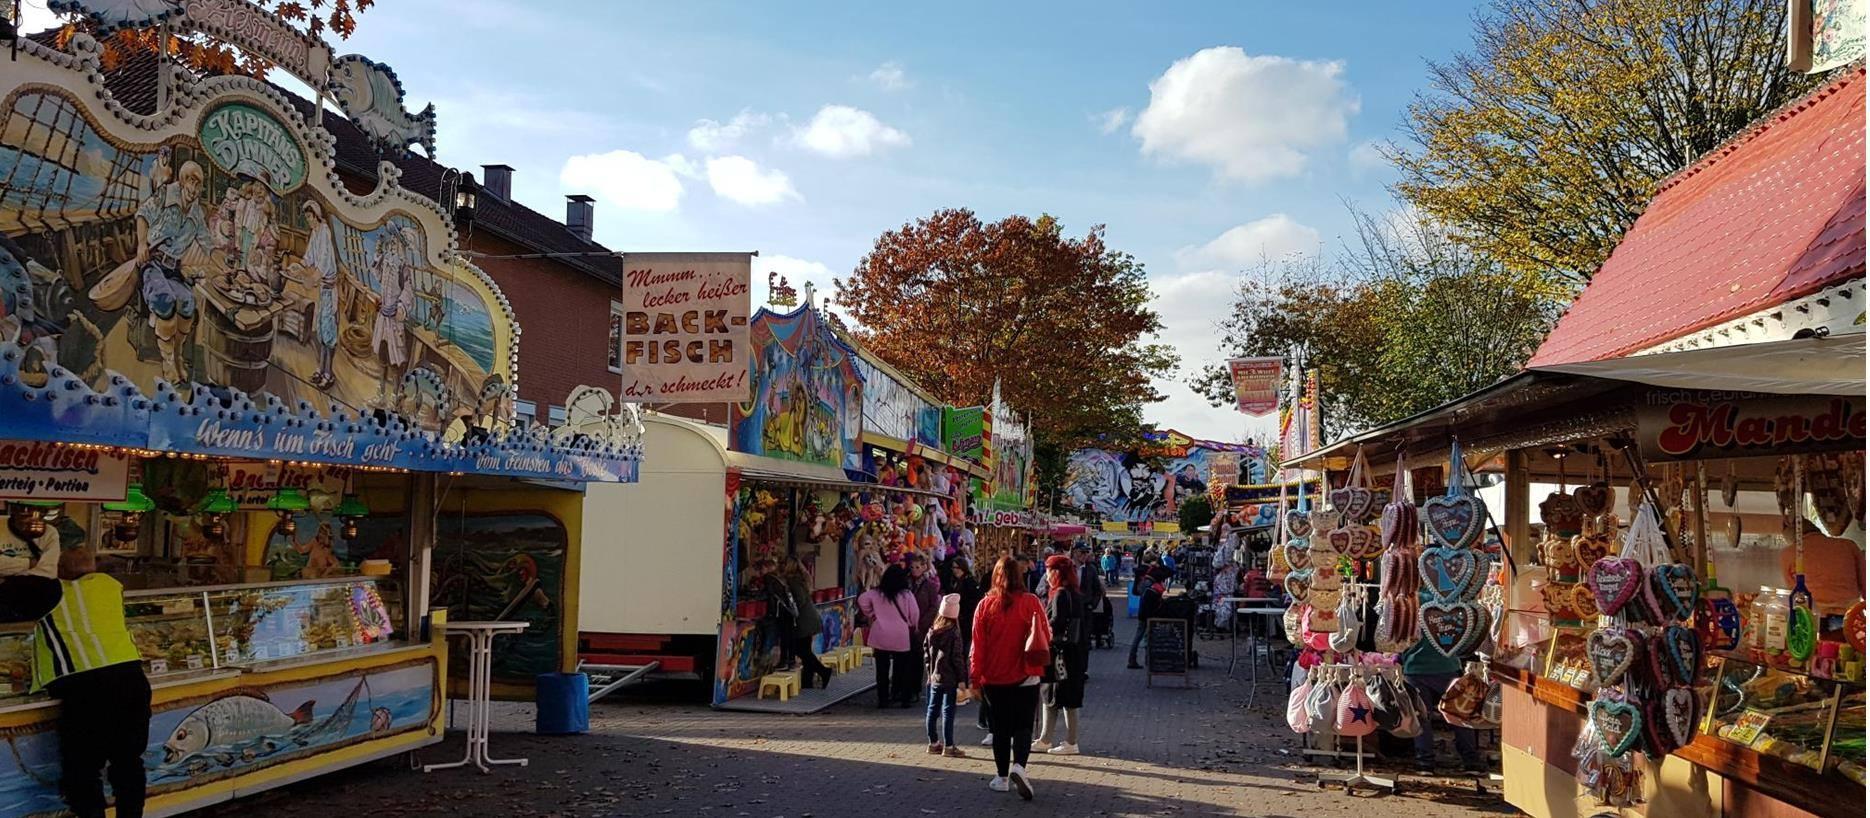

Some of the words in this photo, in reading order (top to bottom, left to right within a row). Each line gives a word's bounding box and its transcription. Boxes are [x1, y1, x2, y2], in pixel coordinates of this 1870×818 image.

[209, 110, 301, 169] KAPITÄNS
[212, 137, 291, 189] DINNER
[643, 288, 690, 308] lecker
[698, 278, 748, 300] heißer
[626, 310, 747, 335] BACK-
[626, 340, 733, 364] FISCH
[195, 418, 264, 450] Wenn's
[273, 427, 304, 453] um
[310, 429, 355, 459] Fisch
[363, 440, 402, 463] geht
[46, 477, 89, 492] Portion
